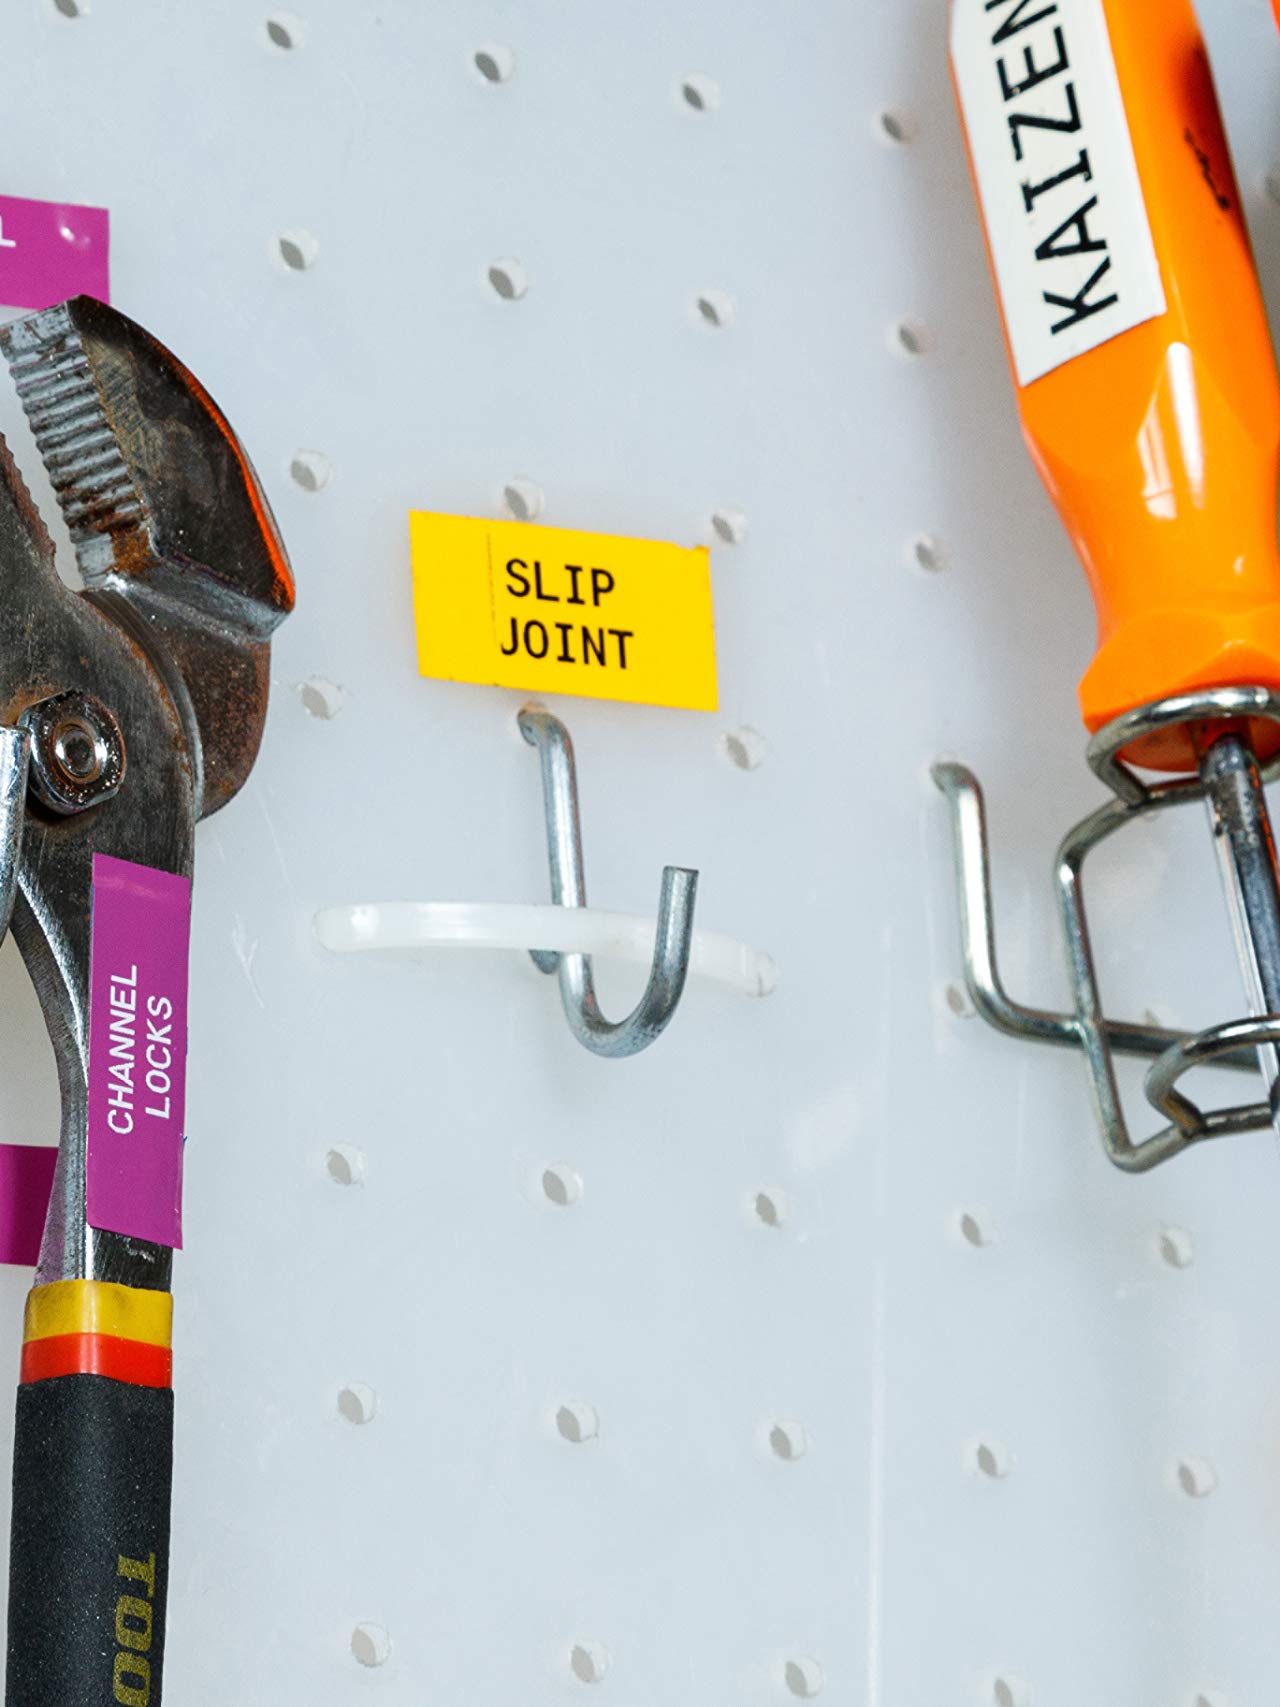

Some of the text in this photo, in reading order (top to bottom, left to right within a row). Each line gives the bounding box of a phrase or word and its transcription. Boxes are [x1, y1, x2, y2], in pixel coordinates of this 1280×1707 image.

[984, 0, 1119, 335] KAIZEN
[500, 617, 634, 669] JOINT
[506, 558, 615, 606] SLIP
[107, 964, 137, 1135] CHANNEL
[145, 995, 173, 1119] LOCKS
[113, 1552, 156, 1707] TOO
